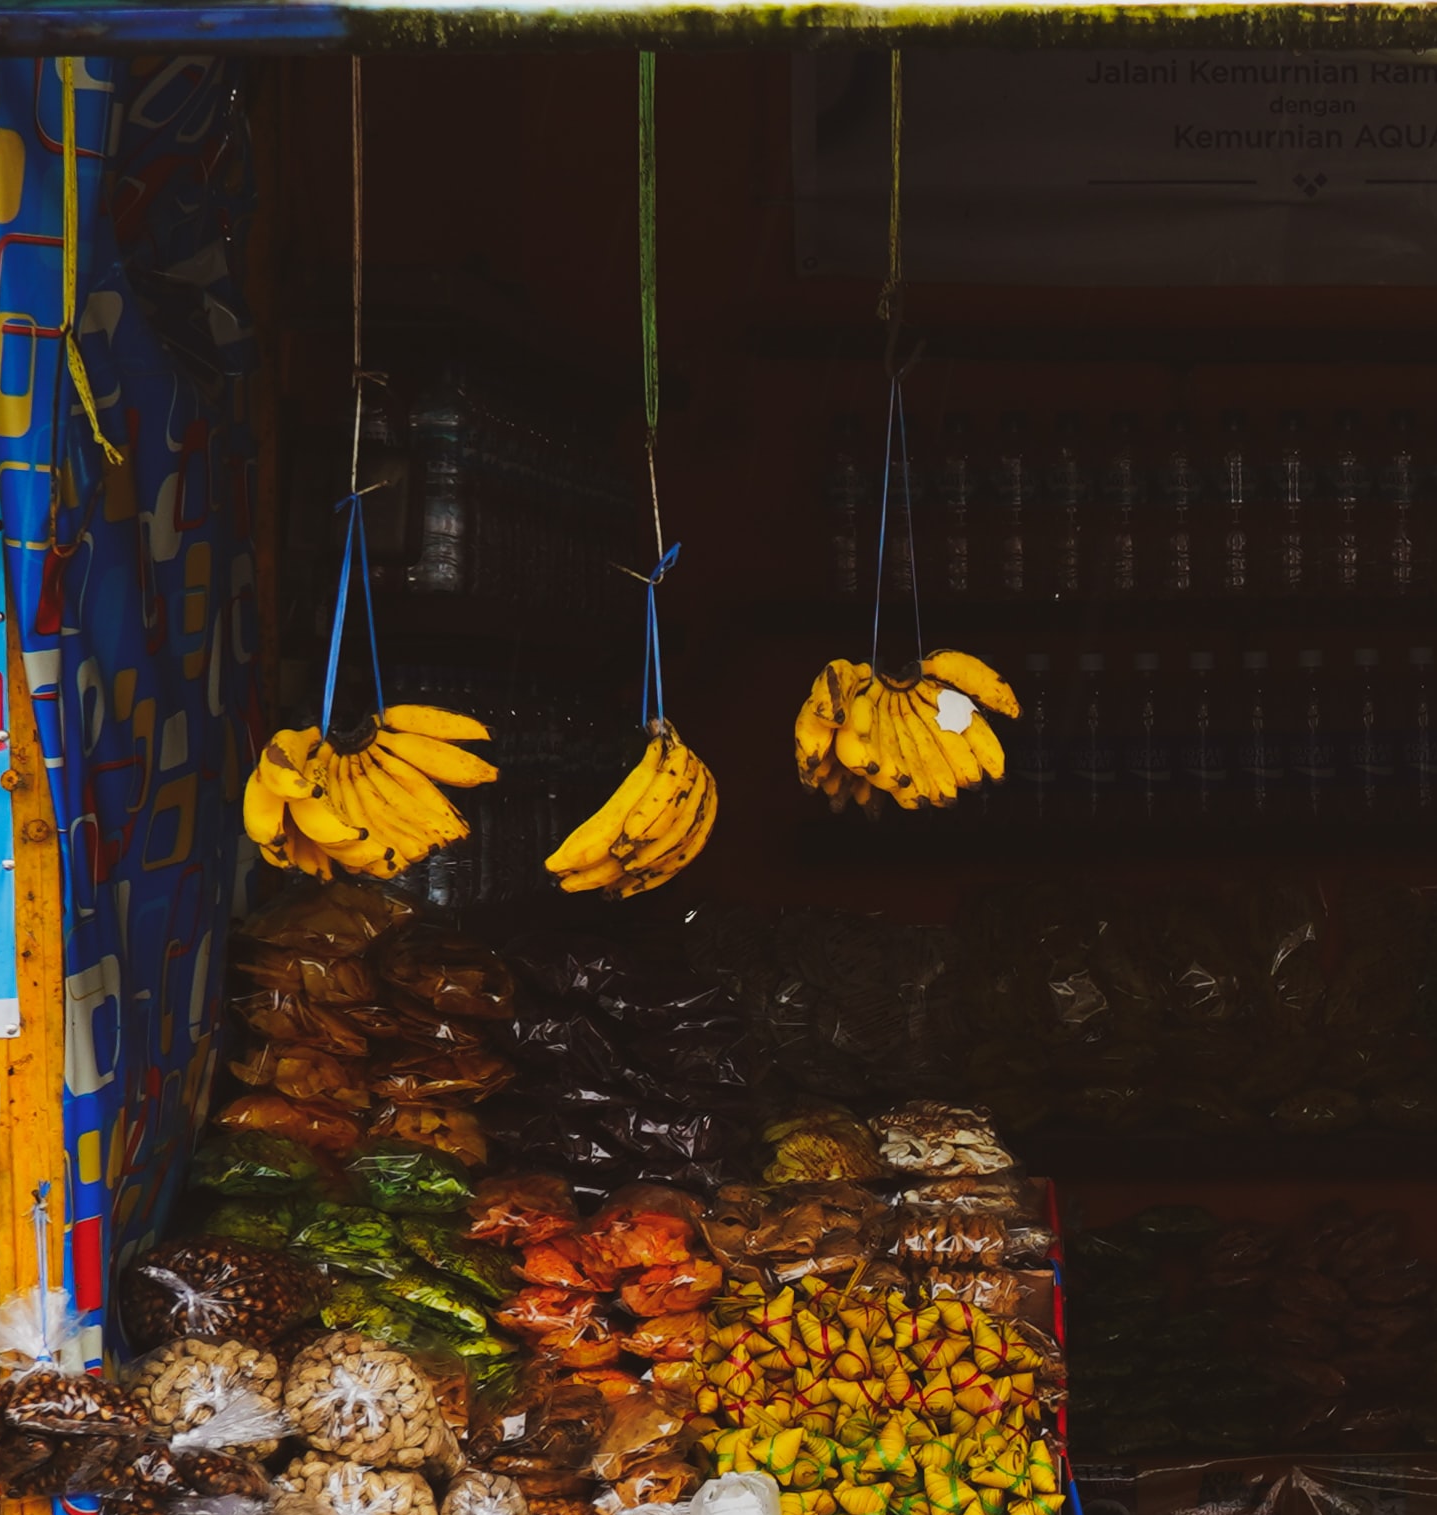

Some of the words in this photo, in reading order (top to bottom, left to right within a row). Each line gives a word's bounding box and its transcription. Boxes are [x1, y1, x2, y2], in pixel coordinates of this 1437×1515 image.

[1086, 61, 1178, 86] Jalani
[1189, 60, 1359, 84] Kemurnian
[1268, 95, 1356, 118] dengan
[1173, 125, 1342, 150] Kemurnian
